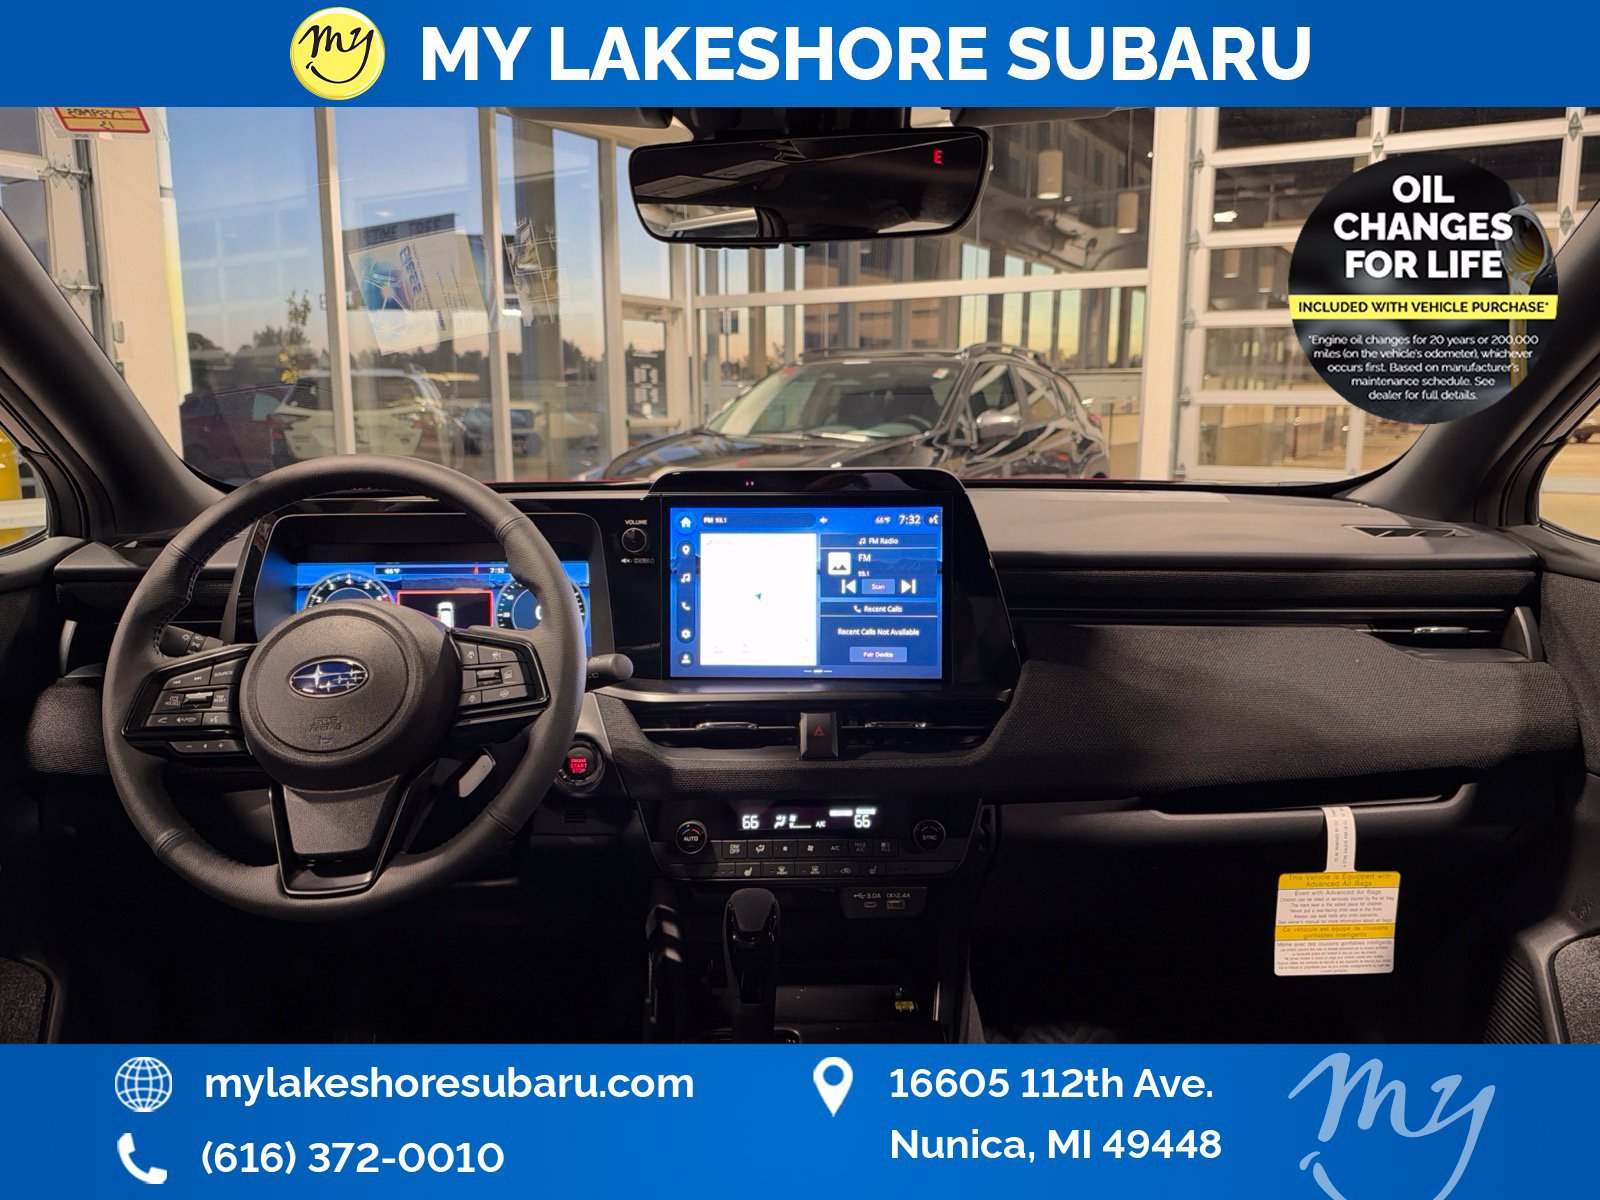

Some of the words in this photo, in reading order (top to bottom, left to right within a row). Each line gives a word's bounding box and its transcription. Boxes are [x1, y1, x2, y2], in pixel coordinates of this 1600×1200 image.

[933, 149, 943, 164] E
[898, 514, 921, 525] 7:32
[868, 537, 879, 545] FM
[880, 537, 899, 545] Radio
[858, 553, 871, 563] FM
[871, 582, 886, 591] Scan
[863, 605, 887, 613] Recent
[887, 605, 903, 613] Calls
[837, 628, 860, 636] Recent
[860, 628, 877, 636] Calls
[877, 628, 890, 636] Not
[890, 628, 920, 636] Available
[741, 814, 760, 830] 66
[853, 814, 872, 829] 66
